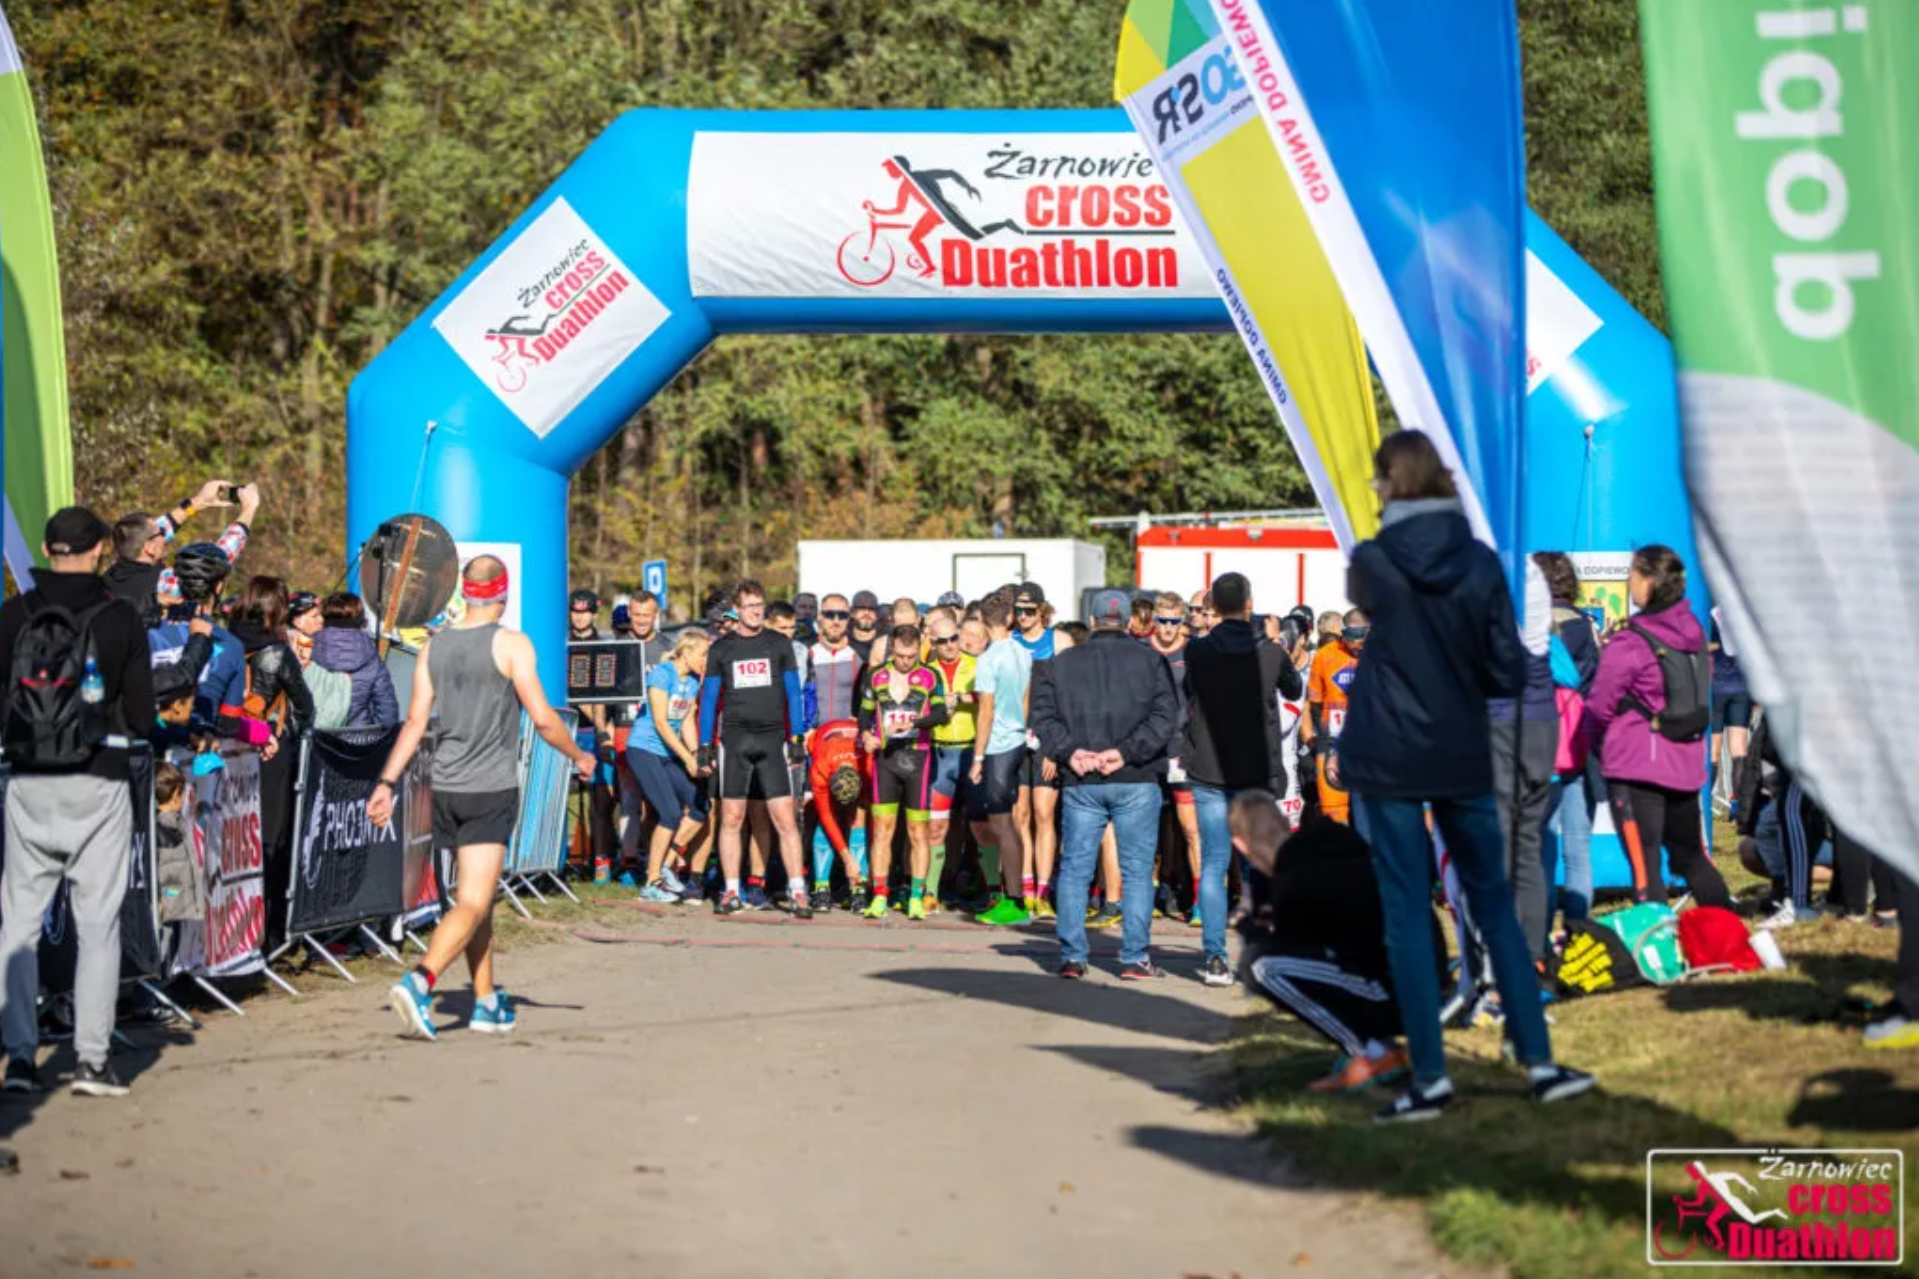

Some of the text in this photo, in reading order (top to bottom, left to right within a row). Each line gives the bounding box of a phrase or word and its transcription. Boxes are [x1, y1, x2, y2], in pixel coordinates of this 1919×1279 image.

[983, 142, 1154, 179] Żarnowie
[1025, 183, 1172, 227] cross
[517, 238, 590, 308] Żarnowiec
[544, 250, 606, 311] cross
[941, 238, 1179, 287] Duathlon
[531, 269, 631, 362] Duathlon
[738, 662, 767, 675] 102
